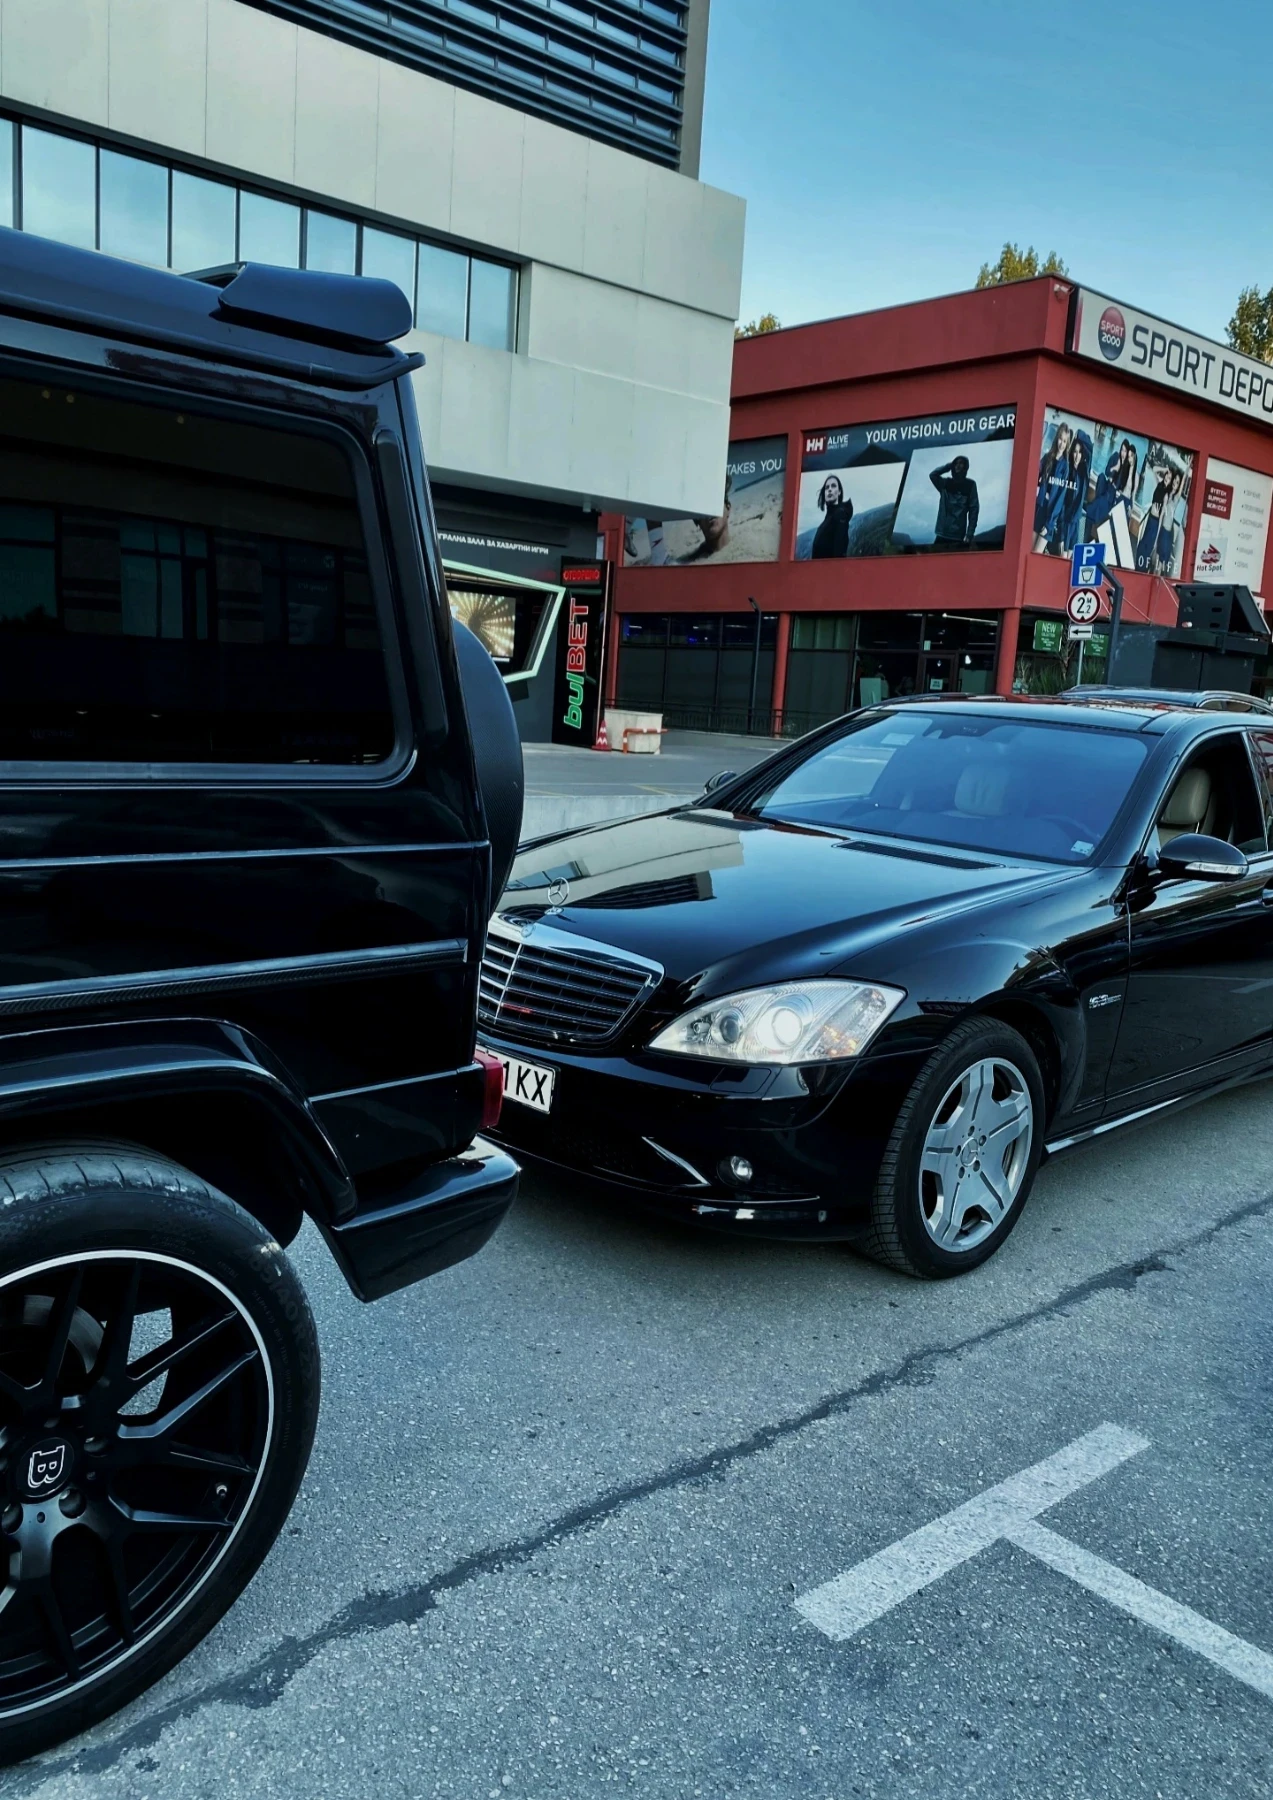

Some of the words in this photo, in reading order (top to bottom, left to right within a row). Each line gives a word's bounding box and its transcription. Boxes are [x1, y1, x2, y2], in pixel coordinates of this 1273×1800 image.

[1101, 319, 1125, 338] SPORT
[1101, 332, 1121, 348] 2000
[1131, 324, 1216, 389] SPORT
[866, 430, 897, 444] YOUR
[900, 423, 944, 440] VISION.
[948, 419, 975, 435] OUR
[978, 413, 1016, 430] GEAR
[828, 434, 849, 446] ALIVE
[727, 461, 756, 475] TAKES
[760, 458, 782, 472] YOU
[1082, 546, 1096, 565] P
[1138, 556, 1151, 569] OF
[1041, 623, 1057, 633] NEW
[564, 597, 589, 729] bulBET
